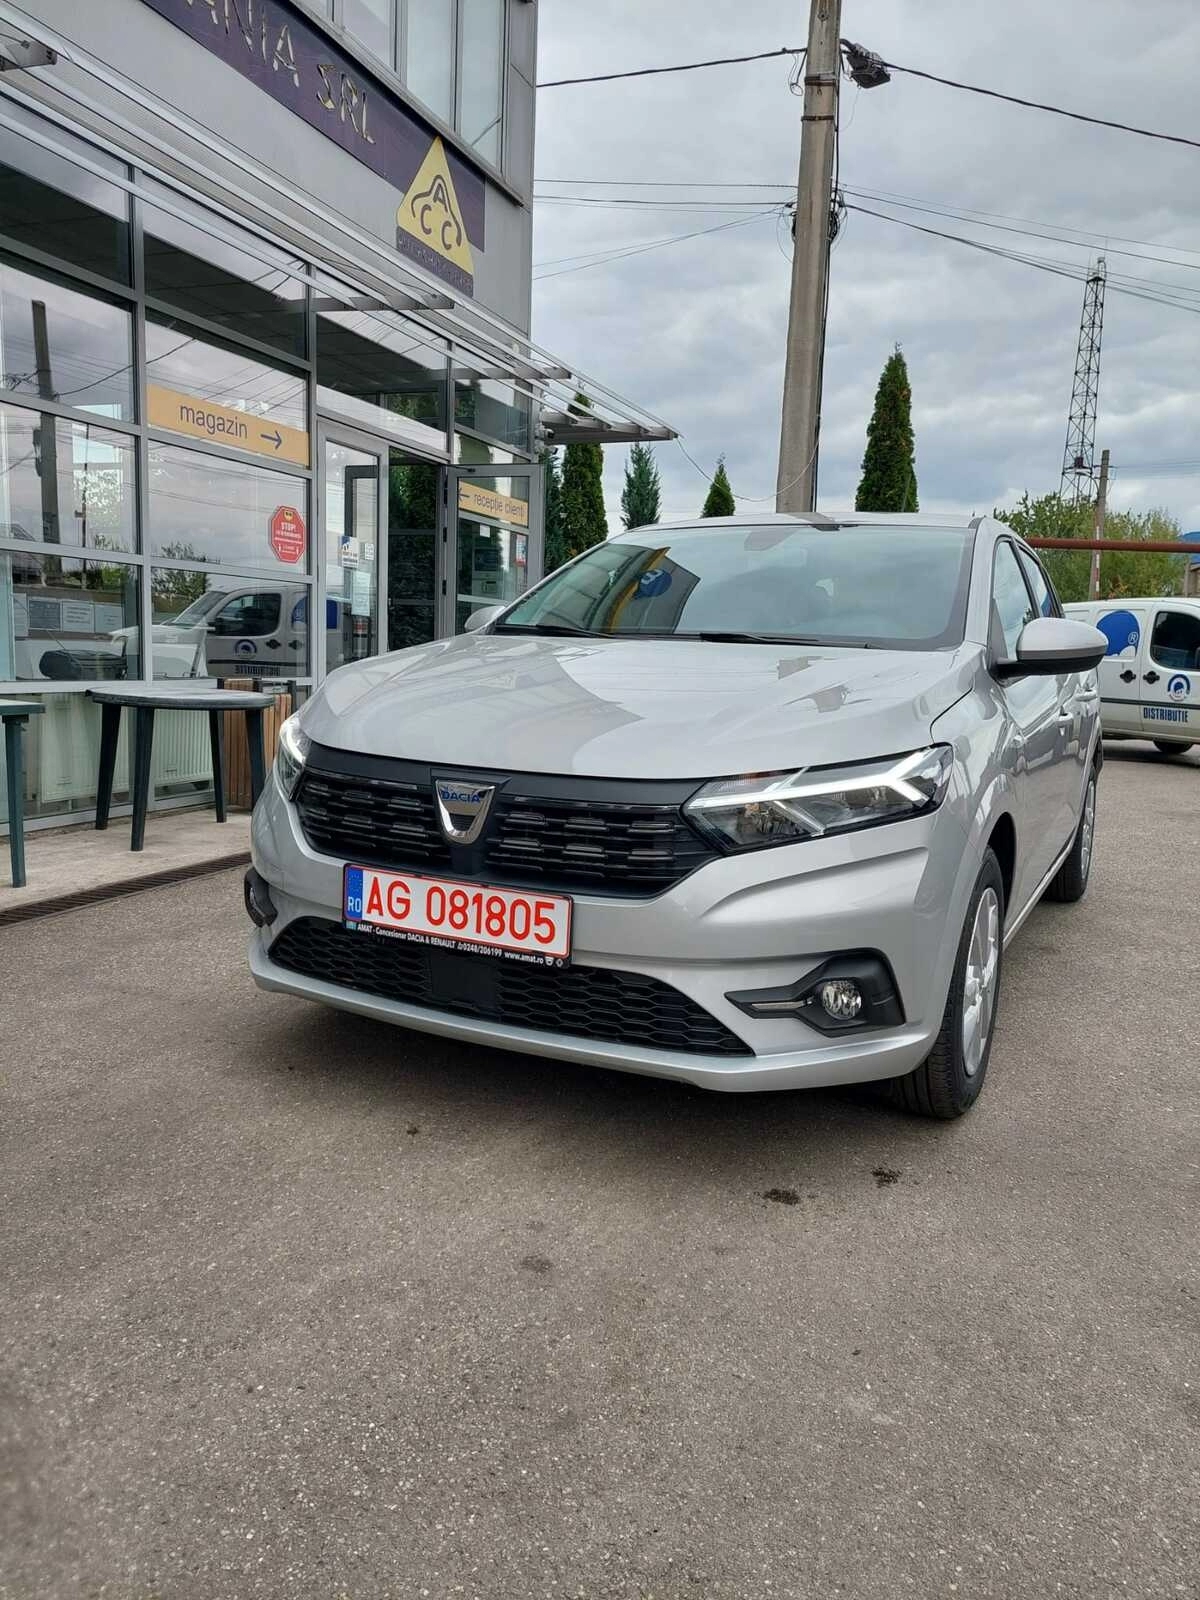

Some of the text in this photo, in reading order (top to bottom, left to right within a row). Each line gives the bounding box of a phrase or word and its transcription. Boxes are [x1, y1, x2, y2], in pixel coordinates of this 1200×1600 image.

[315, 63, 376, 145] SRL
[179, 404, 249, 439] magazin
[1142, 706, 1189, 723] DISTRIBUTIE
[441, 789, 481, 802] DACIA
[347, 896, 362, 913] RO
[366, 876, 556, 945] AG 081805
[357, 922, 373, 934] AMAT
[375, 926, 407, 940] Concesionar
[407, 931, 425, 943] DACIA
[430, 936, 456, 949] RENAULT
